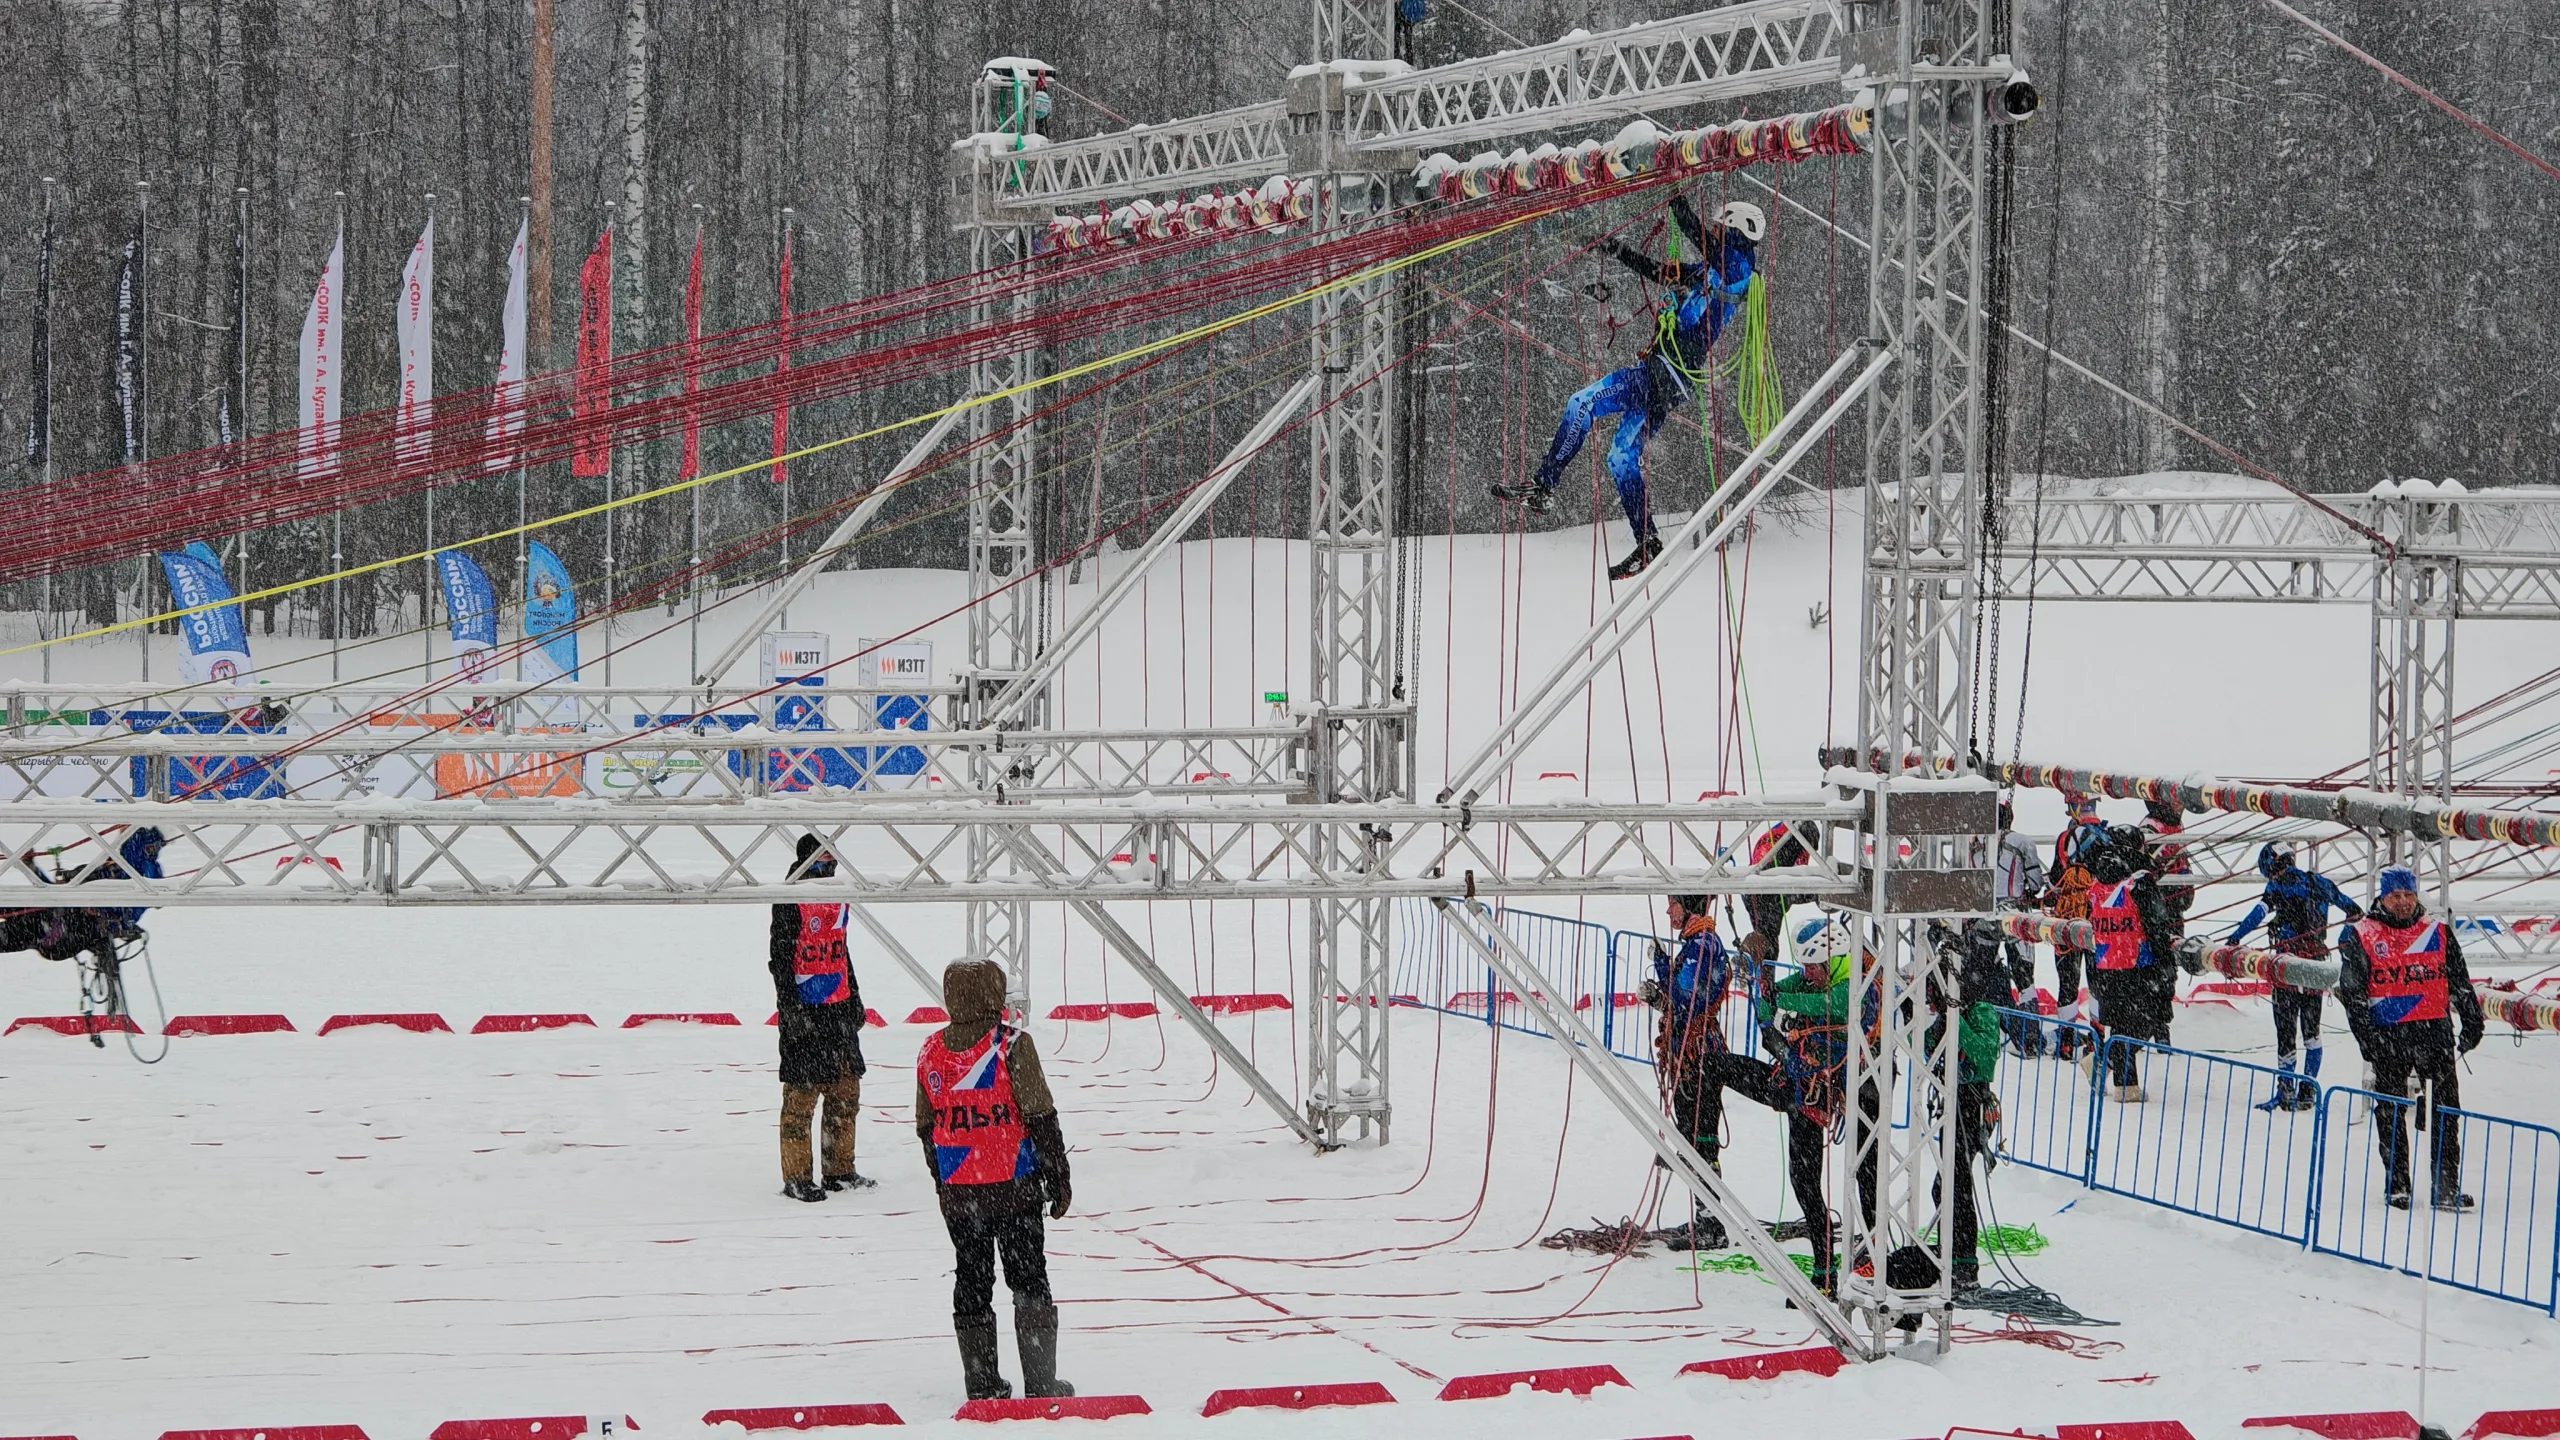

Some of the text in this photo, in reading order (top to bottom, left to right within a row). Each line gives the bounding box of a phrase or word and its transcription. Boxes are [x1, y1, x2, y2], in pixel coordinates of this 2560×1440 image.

[316, 278, 330, 325] «СОЛК
[316, 328, 327, 352] им.
[316, 368, 327, 382] А.
[795, 651, 821, 665] ИЗТТ
[898, 659, 926, 673] ИЗТТ
